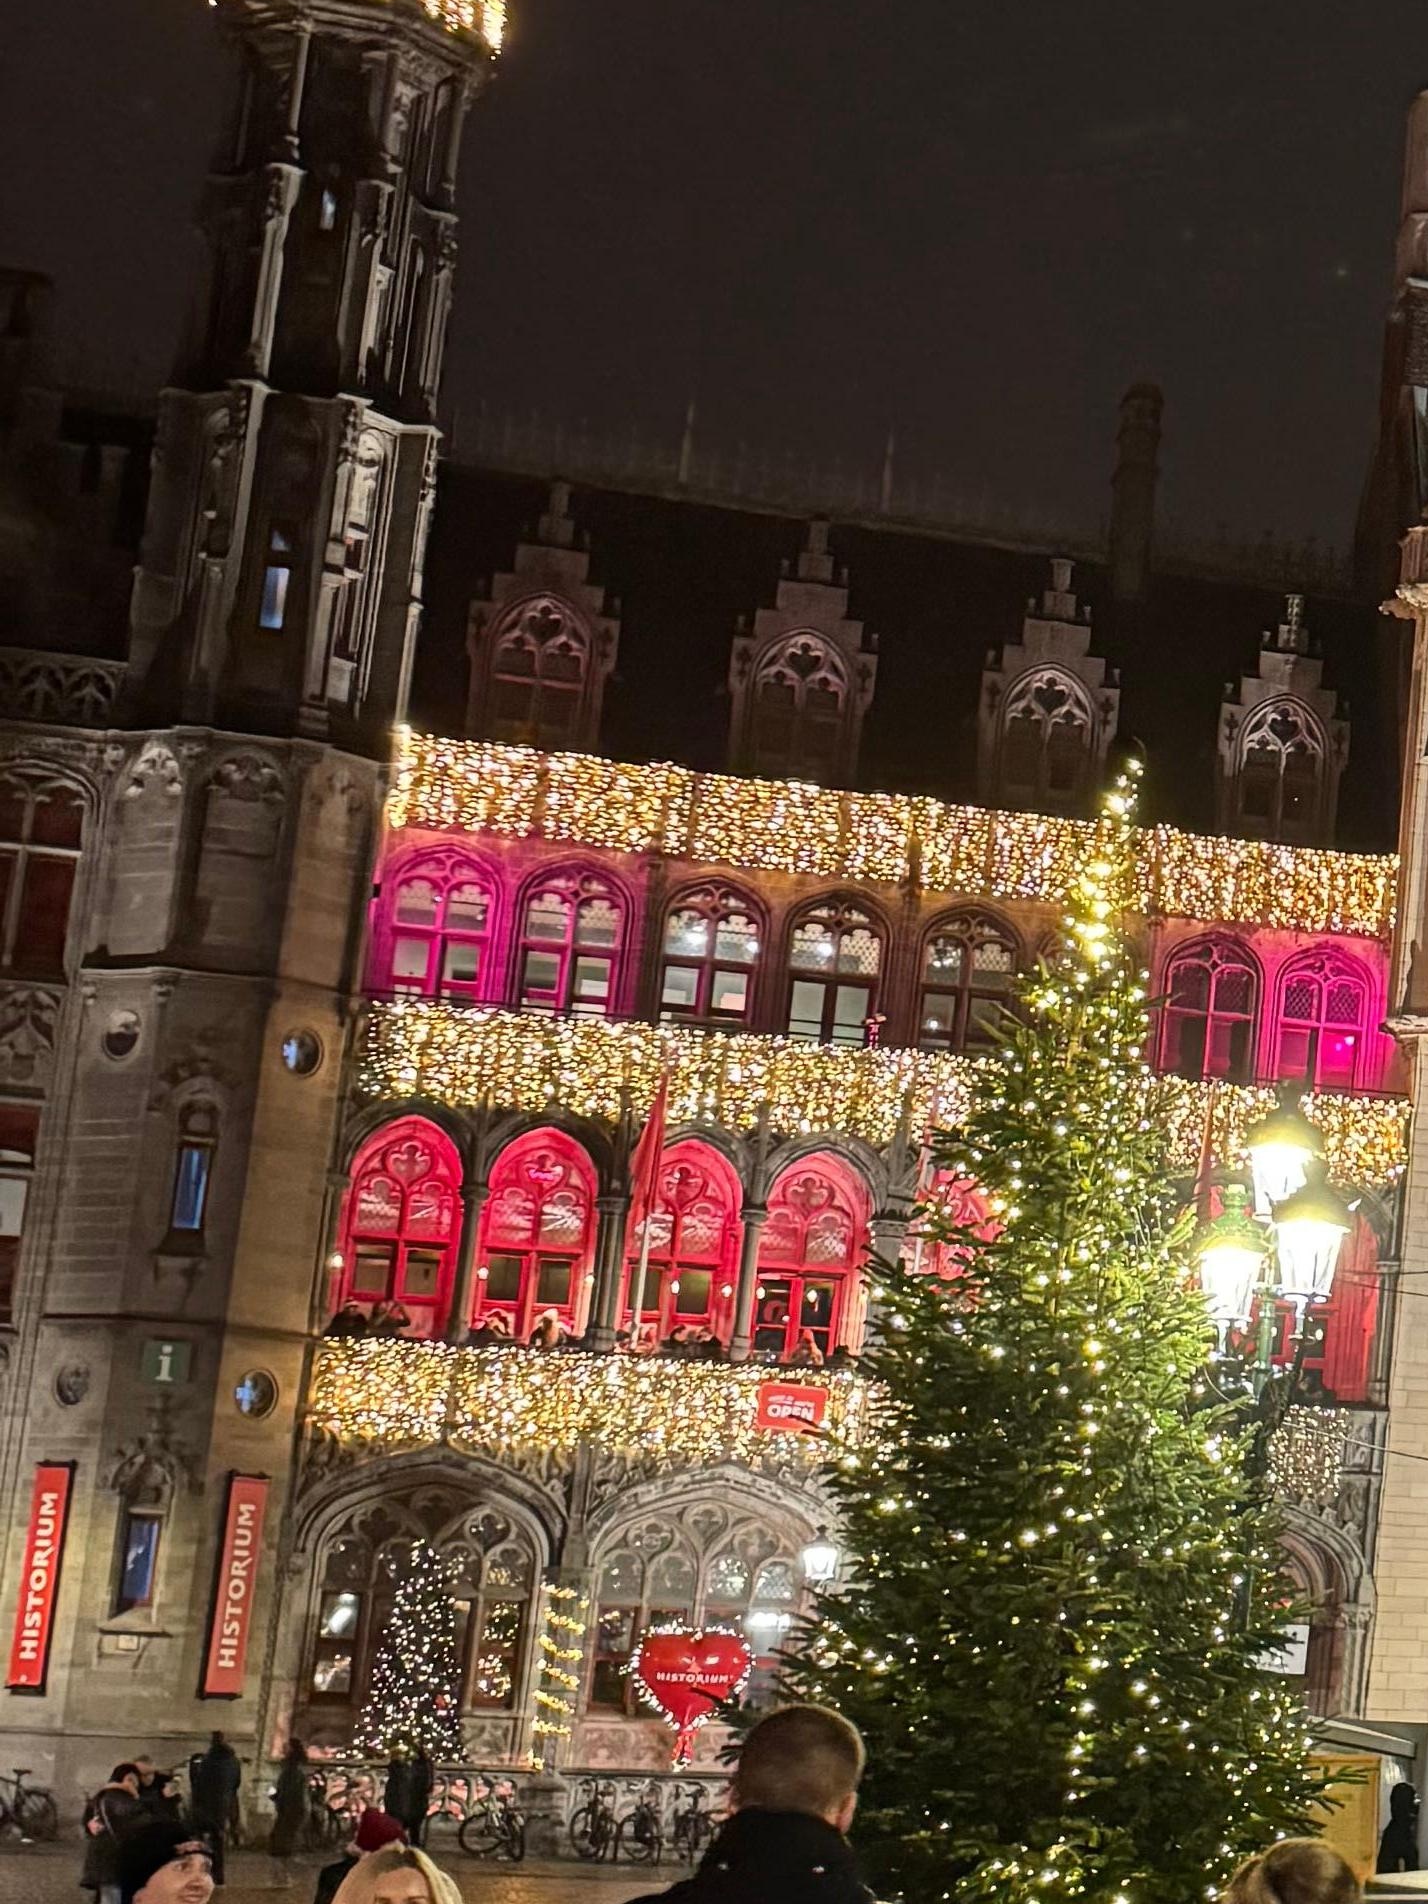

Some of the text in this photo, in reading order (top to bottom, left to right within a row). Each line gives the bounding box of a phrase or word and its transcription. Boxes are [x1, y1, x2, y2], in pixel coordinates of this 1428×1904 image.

[767, 1404, 815, 1421] OPEN
[19, 1492, 59, 1660] HISTORIUM
[217, 1503, 256, 1668] HISTORIUM
